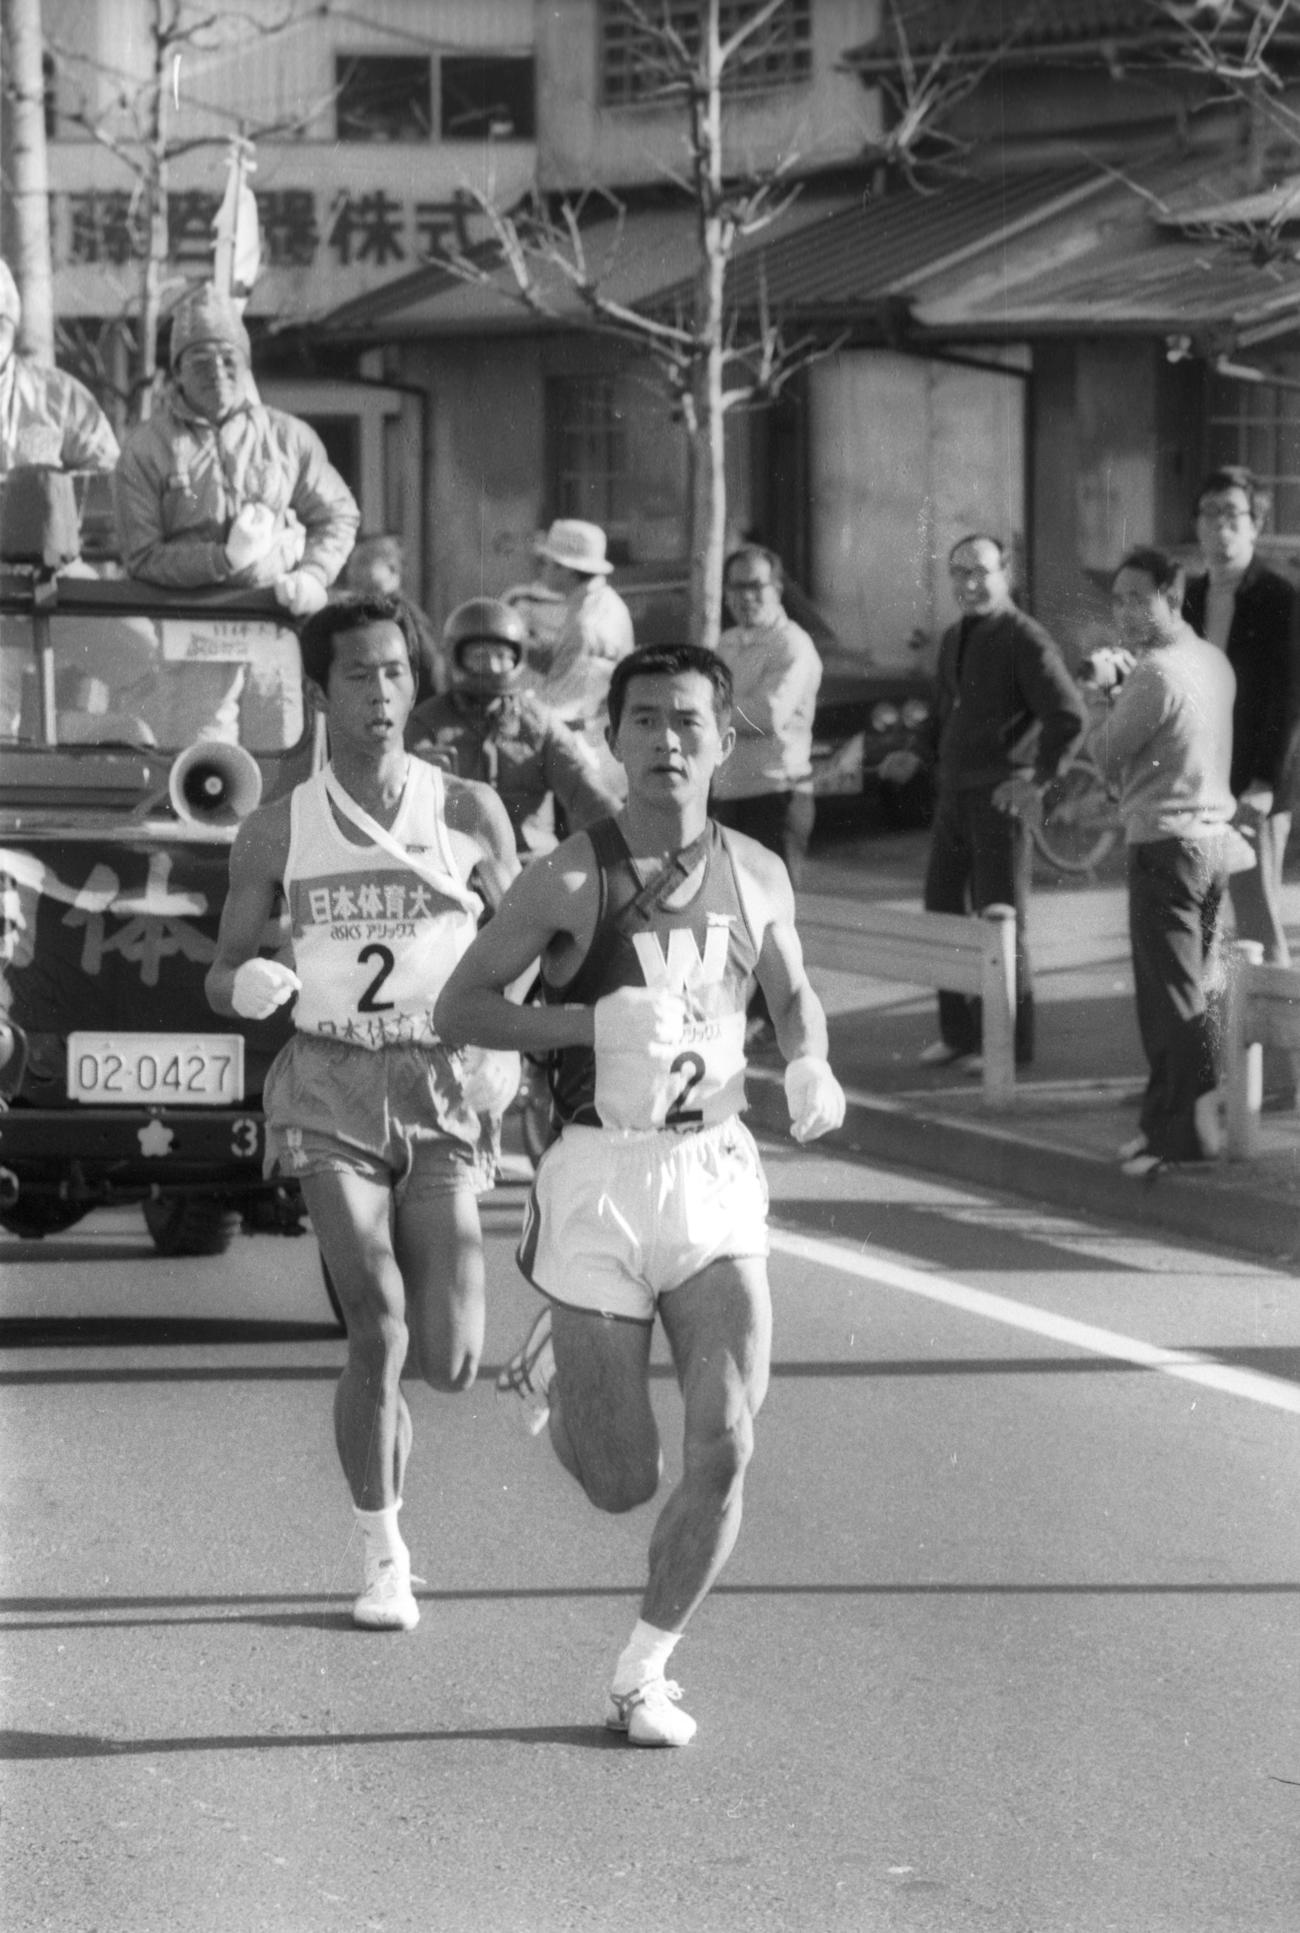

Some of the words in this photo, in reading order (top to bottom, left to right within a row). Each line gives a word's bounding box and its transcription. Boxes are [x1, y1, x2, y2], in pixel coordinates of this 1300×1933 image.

[309, 883, 432, 924] 日本体育大
[357, 943, 395, 1013] 2
[665, 1051, 706, 1125] 2
[231, 1119, 258, 1157] 3
